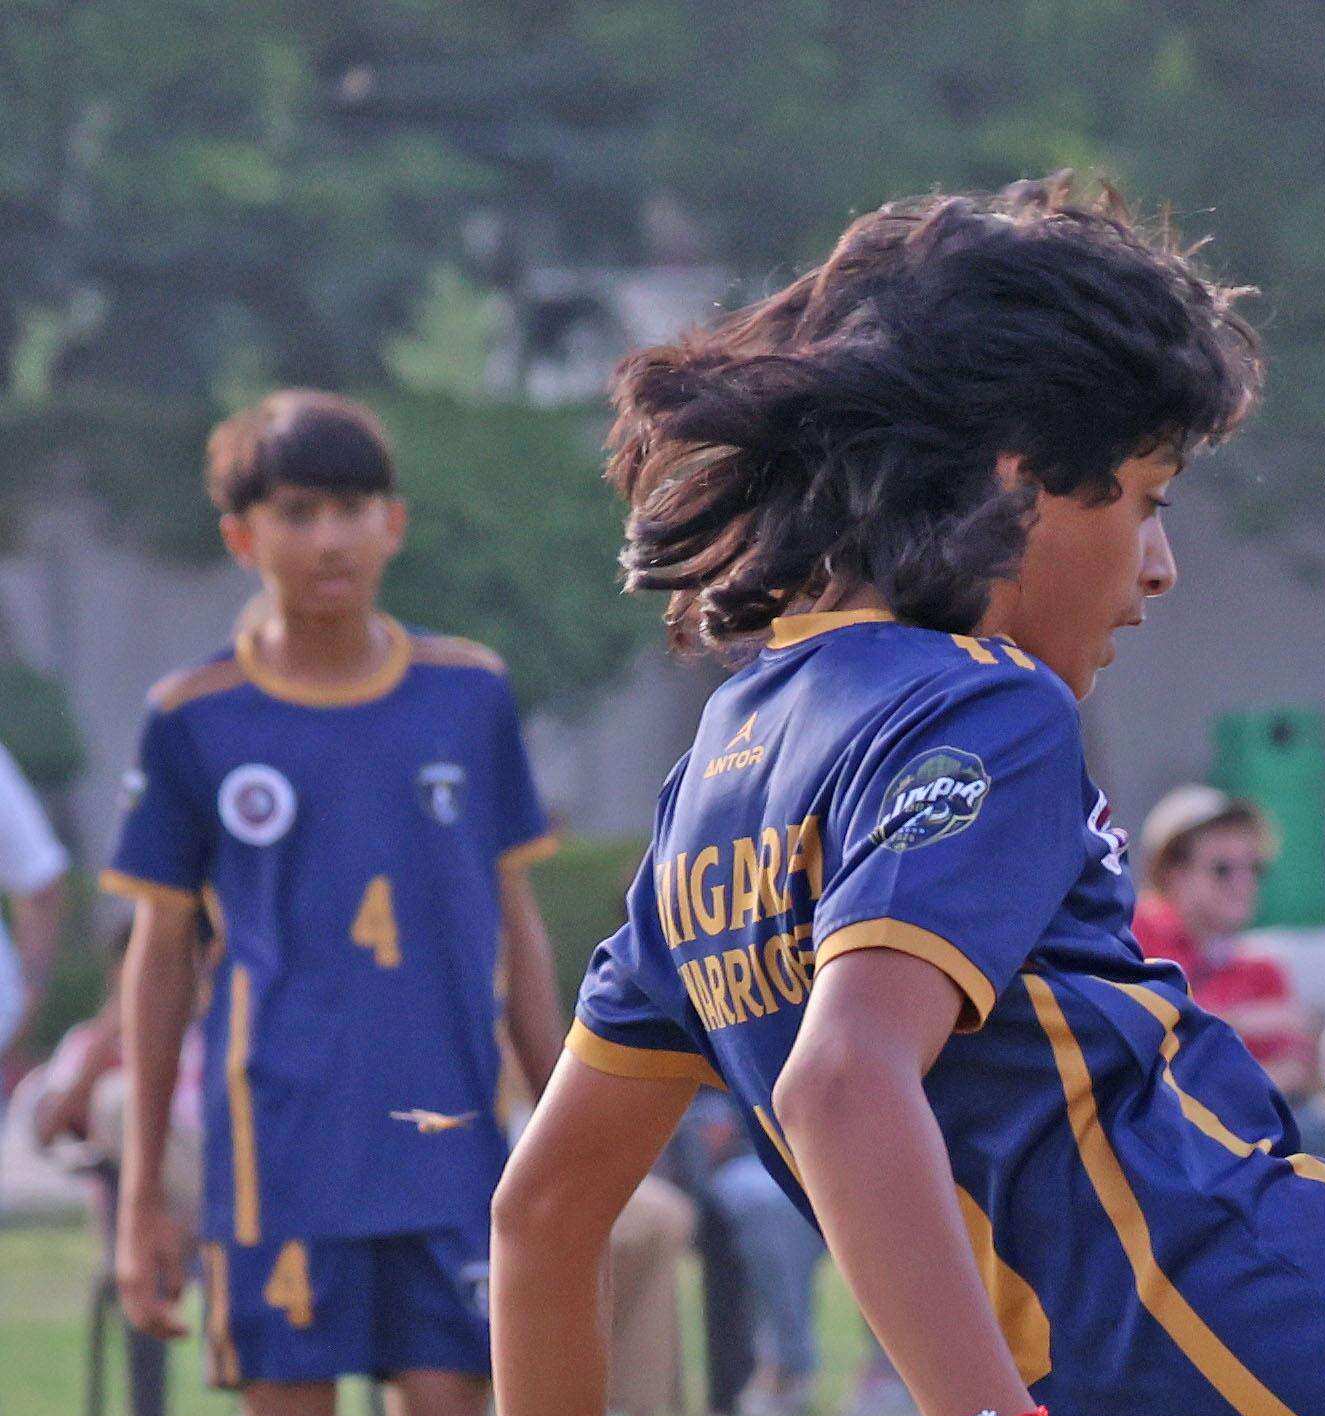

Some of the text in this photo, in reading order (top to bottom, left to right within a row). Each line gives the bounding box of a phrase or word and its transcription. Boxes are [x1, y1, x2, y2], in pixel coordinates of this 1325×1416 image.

[703, 745, 765, 779] ANTOR
[350, 873, 400, 968] 4
[263, 1240, 313, 1328] 4
